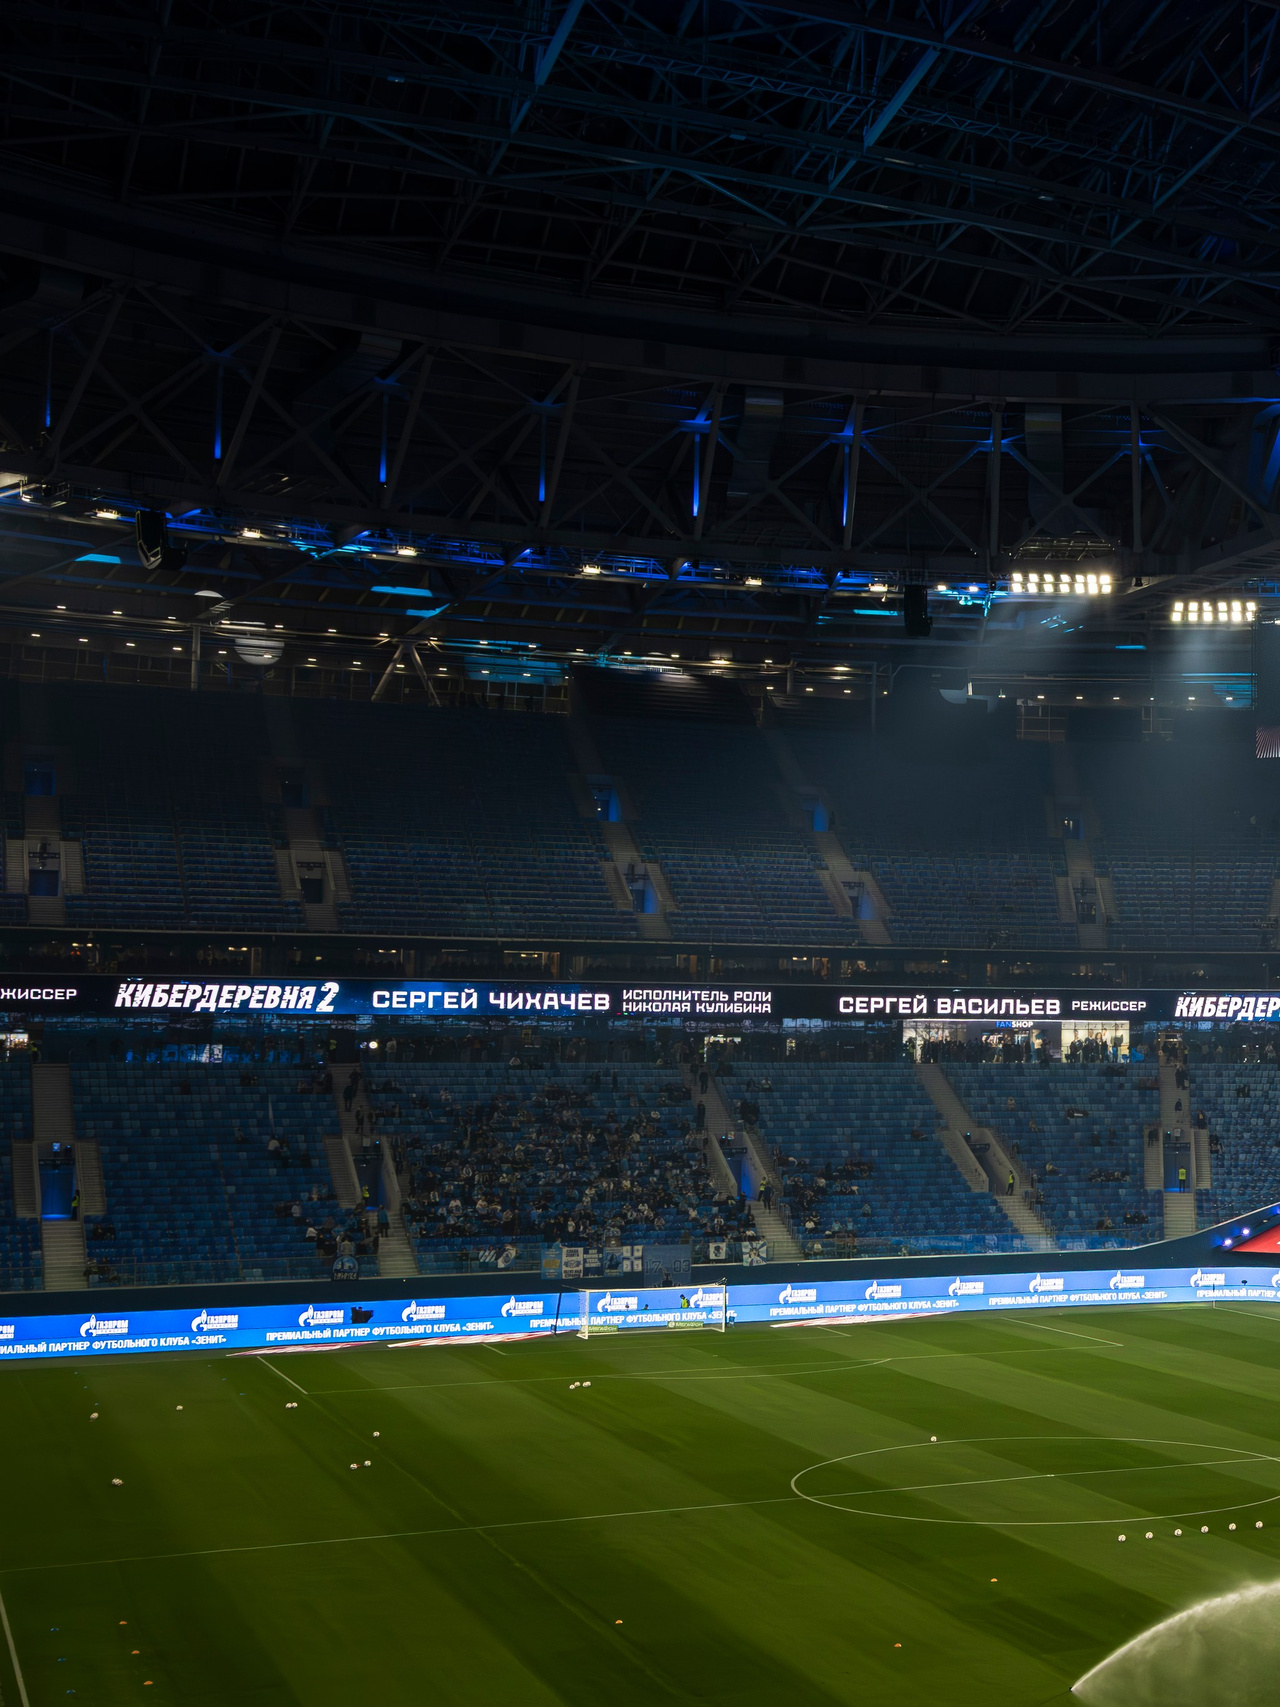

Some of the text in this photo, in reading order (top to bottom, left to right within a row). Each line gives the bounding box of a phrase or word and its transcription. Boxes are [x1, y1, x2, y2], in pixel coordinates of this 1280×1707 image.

[115, 982, 339, 1012] КИБЕРДЕРЕВНЯ 2
[373, 989, 609, 1010] СЕРГЕЙ ЧИХАЧЕВ
[623, 990, 771, 1001] ИСПОЛНИТЕЛЬ РОЛИ
[623, 1002, 771, 1013] НИКОЛАЯ КУЛИБИНА
[840, 995, 1060, 1014] СЕРГЕЙ ВАСИЛЬЕВ
[1072, 1001, 1146, 1011] РЕЖИССЕР
[989, 1295, 1038, 1305] ПРЕМИАЛЬНЫЙ
[1040, 1295, 1068, 1303] ПАРТНЕР
[1070, 1293, 1117, 1301] ФУТБОЛЬНОГО
[1118, 1292, 1140, 1300] КЛУБА
[416, 1306, 445, 1314] ГАЗПРОМ
[516, 1301, 543, 1309] ГАЗПРОМ
[770, 1300, 959, 1316] ПРЕМИАЛЬНЫЙ ПАРТНЕР ФУТБОЛЬНОГО КЛУБА «ЗЕНИТ»
[207, 1315, 238, 1324] ГАЗПРОМ
[314, 1310, 343, 1319] ГАЗПРОМ
[590, 1316, 624, 1325] ПАРТНЕР
[626, 1313, 680, 1323] ФУТБОЛЬНОГО
[682, 1312, 706, 1320] КЛУБА
[96, 1320, 128, 1330] ГАЗПРОМ
[266, 1322, 494, 1341] ПРЕМИАЛЬНЫЙ ПАРТНЕР ФУТБОЛЬНОГО КЛУБА «ЗЕНИТ»
[49, 1342, 90, 1351] ПАРТНЕР
[92, 1338, 158, 1349] ФУТБОЛЬНОГО
[160, 1337, 189, 1346] КЛУБА
[192, 1335, 226, 1344] «ЗЕНИТ»
